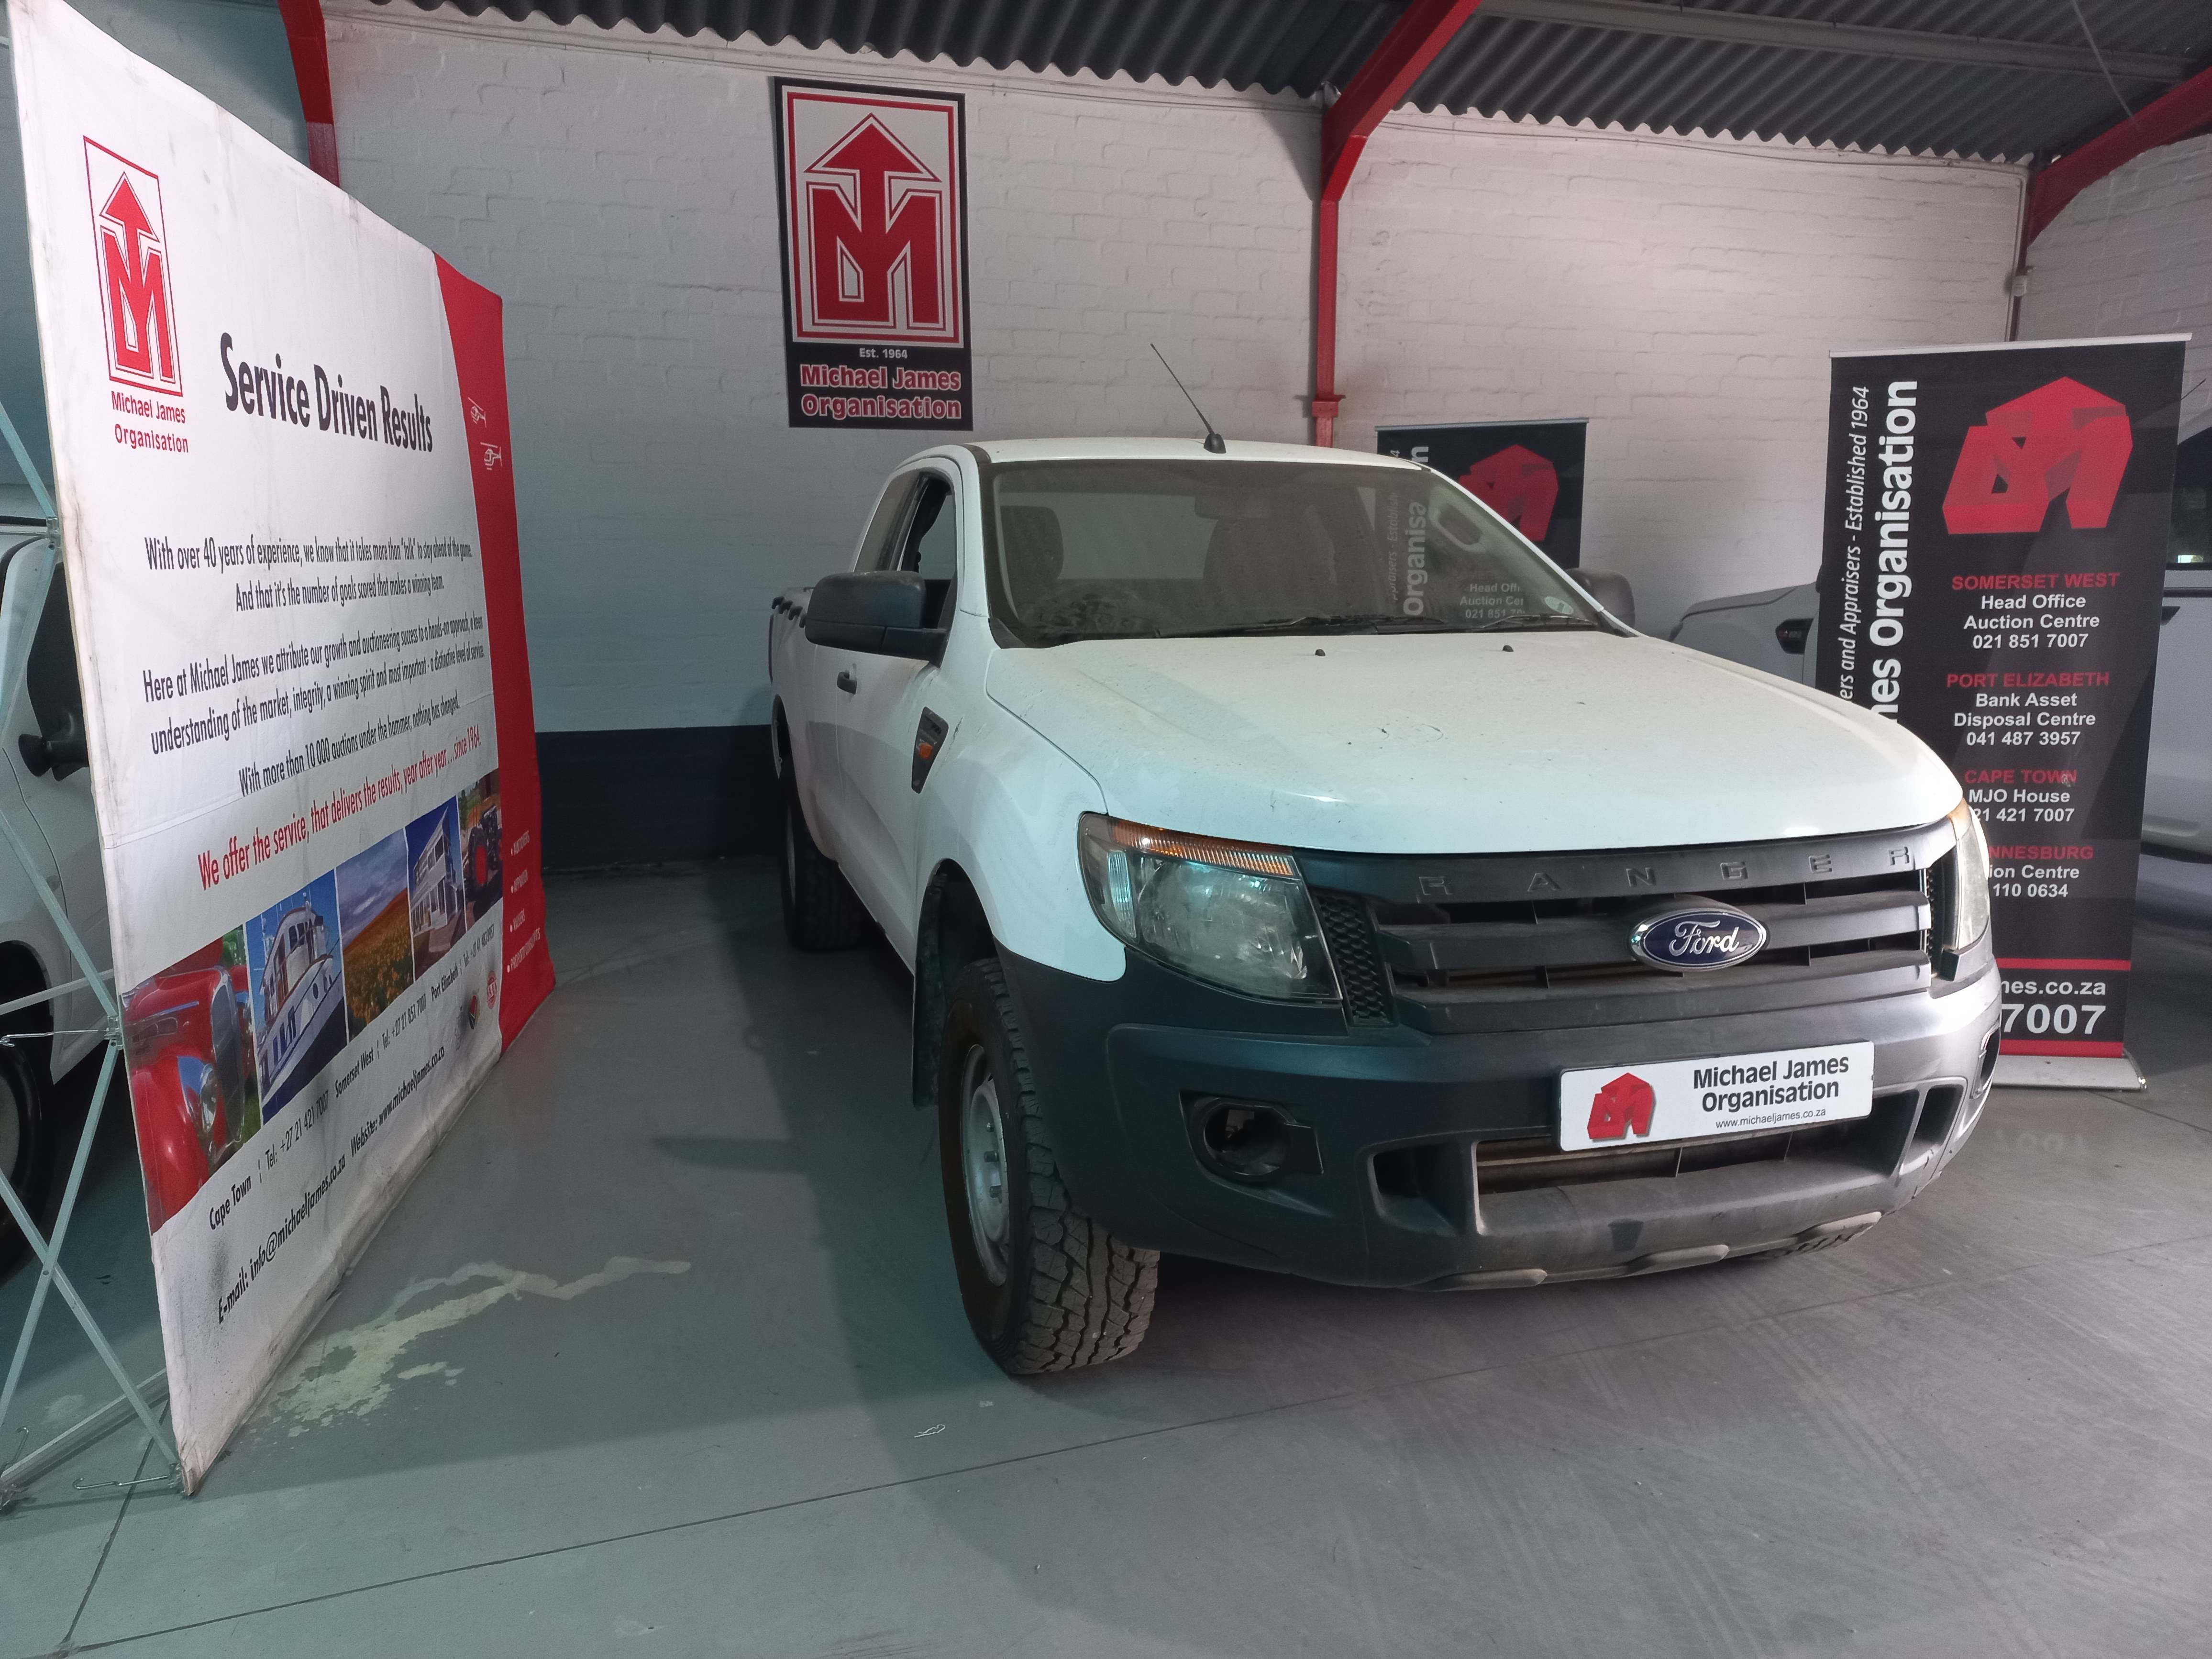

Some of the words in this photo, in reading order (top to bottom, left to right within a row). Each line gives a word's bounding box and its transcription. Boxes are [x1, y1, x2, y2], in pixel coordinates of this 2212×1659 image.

[859, 348, 879, 358] Est.
[883, 349, 908, 359] 1964
[221, 332, 310, 427] Service
[314, 364, 378, 441] Driven
[380, 385, 432, 452] Results
[800, 364, 888, 389] Michael
[892, 367, 962, 391] James
[111, 391, 153, 418] Michael
[156, 401, 186, 424] James
[801, 393, 962, 420] Organisation
[1851, 387, 1869, 429] 1964
[115, 424, 188, 453] Organisation
[1846, 433, 1867, 531] Established
[1869, 381, 1917, 646] Organisation
[144, 536, 174, 570] With
[177, 547, 200, 569] over
[203, 537, 216, 567] 40
[218, 545, 244, 574] years
[246, 533, 255, 564] of
[257, 537, 302, 571] experience,
[303, 544, 314, 562] we
[315, 535, 334, 563] know
[335, 536, 349, 562] that
[349, 539, 355, 561] it
[355, 536, 371, 561] takes
[373, 544, 387, 561] more
[388, 536, 401, 560] than
[417, 541, 423, 559] to
[423, 541, 432, 564] stay
[236, 580, 254, 612] And
[255, 579, 273, 609] that
[274, 580, 286, 607] it's
[288, 577, 300, 605] the
[302, 576, 329, 604] number
[332, 575, 338, 601] of
[340, 575, 357, 607] goals
[358, 573, 376, 598] scored
[377, 573, 389, 597] that
[389, 572, 407, 595] makes
[408, 580, 411, 594] a
[412, 573, 431, 596] winning
[431, 574, 444, 590] team.
[1470, 583, 1497, 593] Head
[1840, 545, 1861, 635] Appraisers
[1952, 574, 2059, 590] SOMERSET
[2064, 573, 2120, 588] WEST
[1460, 596, 1503, 606] Auction
[1465, 609, 1483, 619] 021
[1981, 595, 2026, 609] Head
[2033, 594, 2086, 609] Office
[1964, 615, 2033, 629] Auction
[2040, 614, 2100, 628] Centre
[1838, 637, 1856, 670] and
[1973, 634, 2002, 649] 021
[2009, 634, 2038, 648] 851
[2046, 633, 2089, 648] 7007
[143, 669, 173, 702] Here
[177, 669, 187, 697] at
[190, 654, 229, 693] Michael
[232, 654, 260, 683] James
[261, 654, 274, 675] we
[276, 641, 309, 672] attribute
[310, 645, 322, 664] our
[324, 633, 347, 668] growth
[349, 630, 361, 657] and
[362, 628, 400, 653] auctioneering
[401, 628, 418, 645] success
[418, 624, 424, 641] to
[424, 628, 428, 641] a
[1947, 674, 1998, 688] PORT
[2003, 672, 2110, 687] ELIZABETH
[151, 707, 230, 754] understanding
[232, 698, 240, 730] of
[243, 696, 257, 727] the
[260, 687, 292, 719] market,
[293, 681, 325, 714] integrity,
[327, 685, 332, 702] a
[332, 674, 359, 700] winning
[360, 668, 375, 697] spirit
[376, 662, 387, 688] and
[388, 663, 401, 684] most
[401, 657, 427, 685] important
[1976, 693, 2020, 707] Bank
[2024, 692, 2078, 707] Asset
[1954, 712, 2031, 729] Disposal
[2037, 712, 2096, 726] Centre
[239, 762, 261, 797] With
[263, 762, 285, 787] more
[286, 749, 304, 777] than
[305, 742, 315, 769] 10
[316, 737, 330, 765] 000
[332, 732, 358, 760] auctions
[359, 721, 376, 749] under
[377, 718, 387, 741] the
[387, 714, 412, 737] hammer,
[412, 703, 431, 728] nothing
[431, 699, 440, 720] has
[1967, 731, 1995, 745] 041
[2002, 731, 2033, 745] 487
[2039, 731, 2080, 745] 3957
[1964, 769, 2015, 784] CAPE
[2021, 769, 2078, 784] TOWN
[1969, 789, 2007, 803] MJO
[2013, 789, 2070, 803] House
[198, 850, 219, 891] We
[223, 836, 249, 879] offer
[253, 827, 271, 865] the
[273, 813, 310, 854] service,
[311, 799, 329, 834] that
[332, 787, 363, 824] delivers
[363, 776, 376, 808] the
[377, 764, 403, 799] results,
[403, 764, 418, 794] year
[419, 750, 433, 779] after
[434, 749, 447, 778] year
[1996, 808, 2026, 821] 421
[2033, 808, 2075, 821] 7007
[1418, 846, 1914, 897] RANGER
[2021, 864, 2079, 878] Centre
[1993, 884, 2021, 897] 110
[2027, 884, 2068, 897] 0634
[1669, 920, 1740, 956] Ford
[2001, 1004, 2106, 1034] 7007
[335, 1060, 359, 1097] Somerset
[361, 1046, 374, 1071] West
[408, 1004, 416, 1024] 851
[1693, 1061, 1777, 1089] Michael
[1783, 1056, 1849, 1080] James
[1702, 1081, 1839, 1113] Organisation
[1716, 1108, 1826, 1128] www.michaeljames.co.za
[209, 1198, 230, 1230] Cape
[231, 1176, 252, 1206] Town
[265, 1144, 277, 1170] Tel:
[280, 1126, 293, 1152] +27
[295, 1118, 302, 1141] 21
[304, 1106, 314, 1130] 421
[316, 1090, 329, 1120] 7007
[218, 1266, 249, 1324] E-mail:
[250, 1154, 345, 1281] info@michaeljames.co.za
[351, 1118, 377, 1158] Website:
